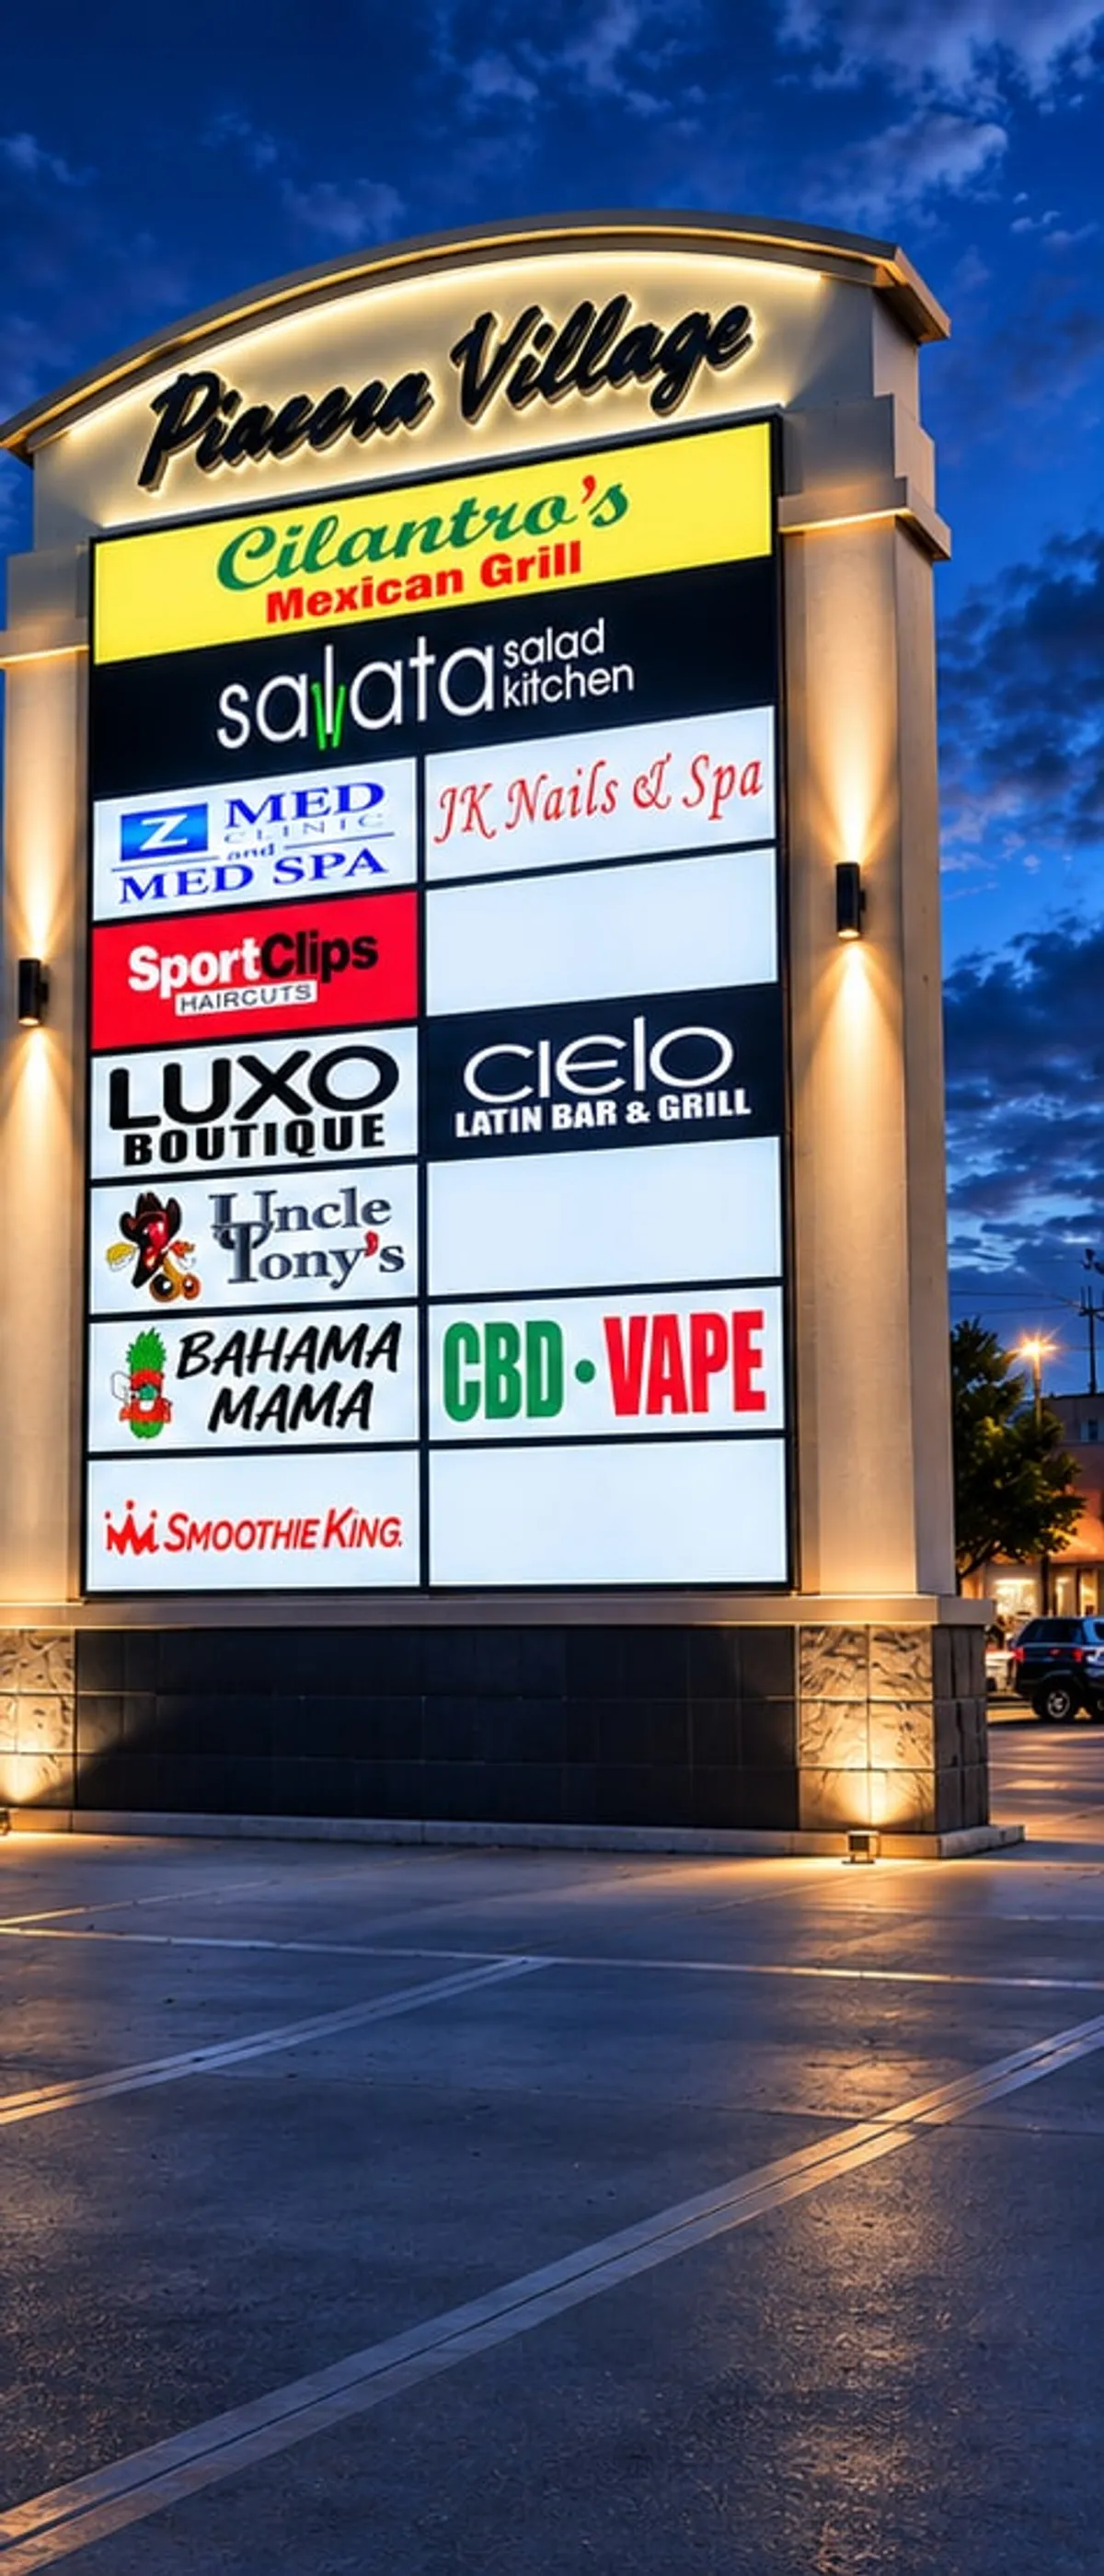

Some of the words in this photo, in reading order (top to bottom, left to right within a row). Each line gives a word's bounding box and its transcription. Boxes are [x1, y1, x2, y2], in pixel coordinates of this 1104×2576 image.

[450, 293, 753, 426] Village
[215, 475, 629, 592] Cilantro's
[265, 568, 464, 624] Mexican
[479, 540, 582, 589] Grill
[503, 617, 605, 670] salad
[216, 637, 495, 751] salata
[503, 661, 635, 709] kitchen
[224, 782, 385, 828] MED
[433, 782, 498, 844] JK
[504, 760, 619, 829] Nails
[633, 753, 673, 810] &
[683, 753, 764, 821] Spa
[224, 813, 384, 845] CLINIC
[227, 844, 276, 861] and
[119, 863, 255, 905] MED
[273, 847, 389, 886] SPA
[180, 984, 313, 1014] HAIRCUTS
[109, 1045, 400, 1130] LUXO
[454, 1106, 543, 1138] LATIN
[552, 1100, 617, 1132] BAR
[626, 1099, 651, 1124] &
[659, 1088, 752, 1121] GRILL
[123, 1113, 385, 1167] BOUTIQUE
[208, 1186, 393, 1248] Uncle
[212, 1221, 406, 1290] Tony's
[176, 1321, 403, 1379] BAHAMA
[443, 1320, 564, 1422] CBD
[603, 1309, 766, 1417] VAPE
[207, 1380, 374, 1433] MAMA
[164, 1512, 320, 1553] SMOOTHIE
